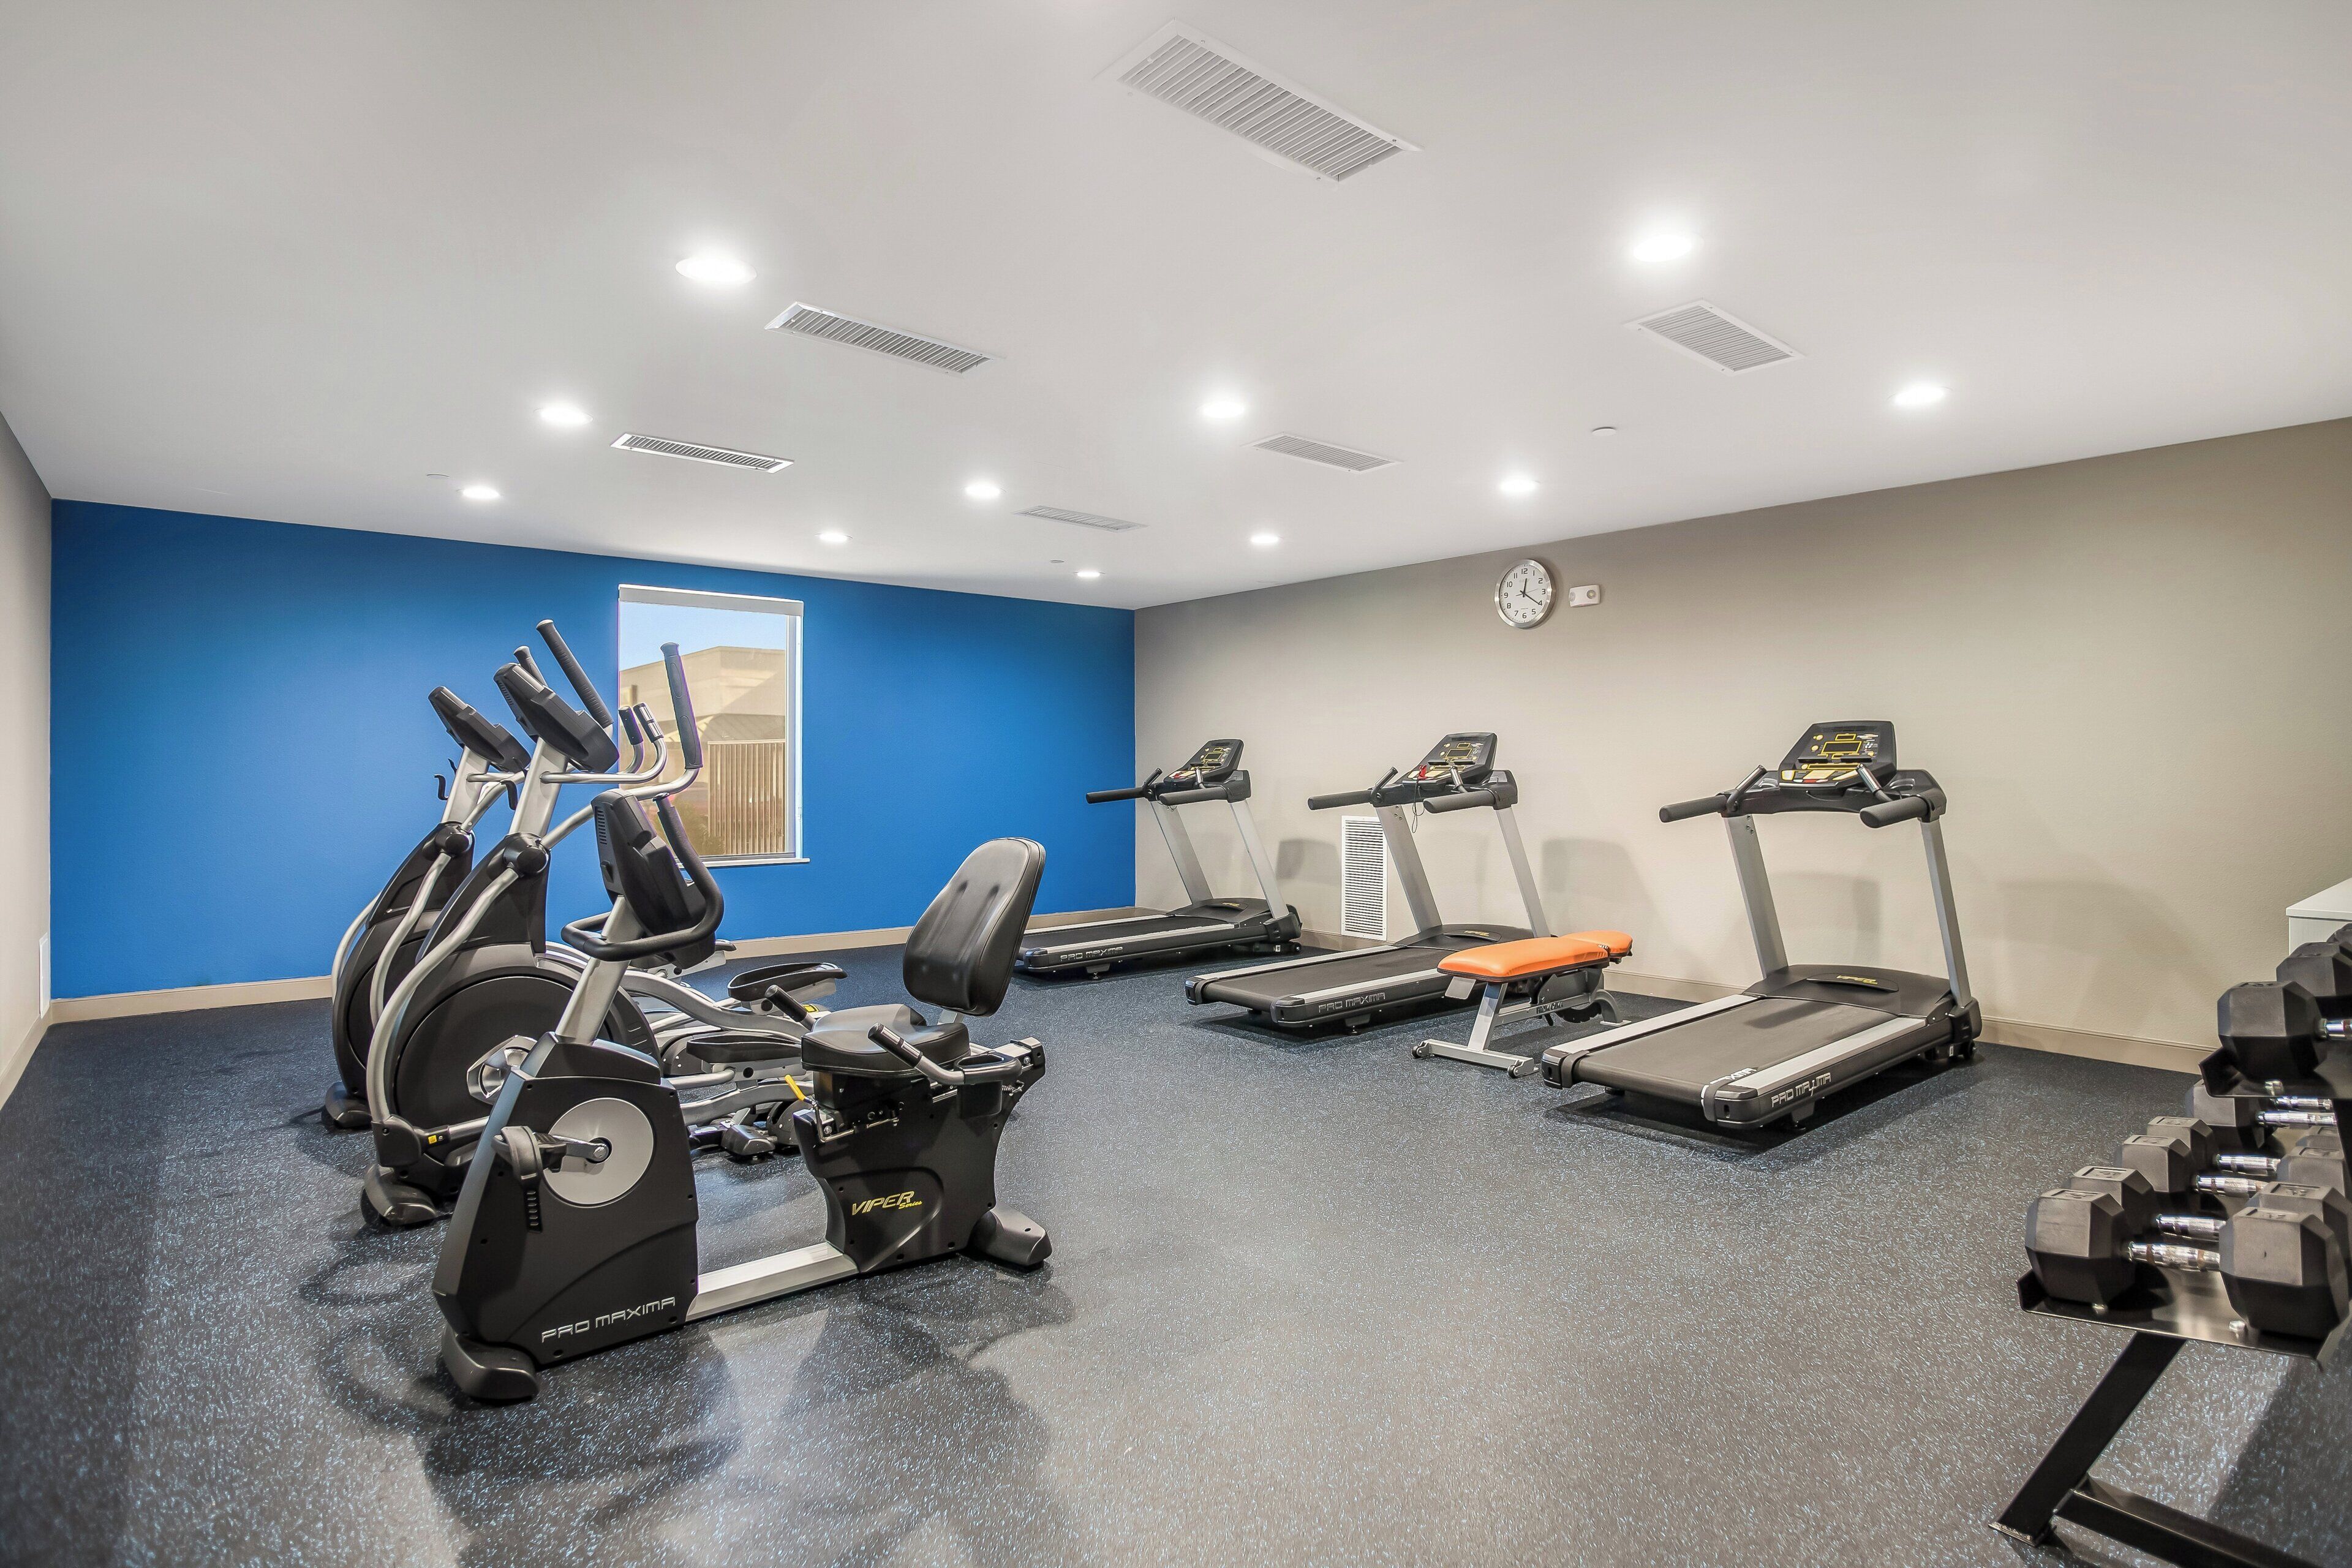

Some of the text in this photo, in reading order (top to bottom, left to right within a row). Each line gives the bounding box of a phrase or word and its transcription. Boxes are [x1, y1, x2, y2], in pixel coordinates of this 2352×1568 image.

[1060, 946, 1124, 962] PRO MAXIMA
[1318, 992, 1385, 1013] PRO MAXIMA
[1771, 1088, 1794, 1108] PRO
[851, 1191, 914, 1216] VIPER
[899, 1200, 922, 1210] Series
[541, 1297, 676, 1343] PRO MAXIMA
